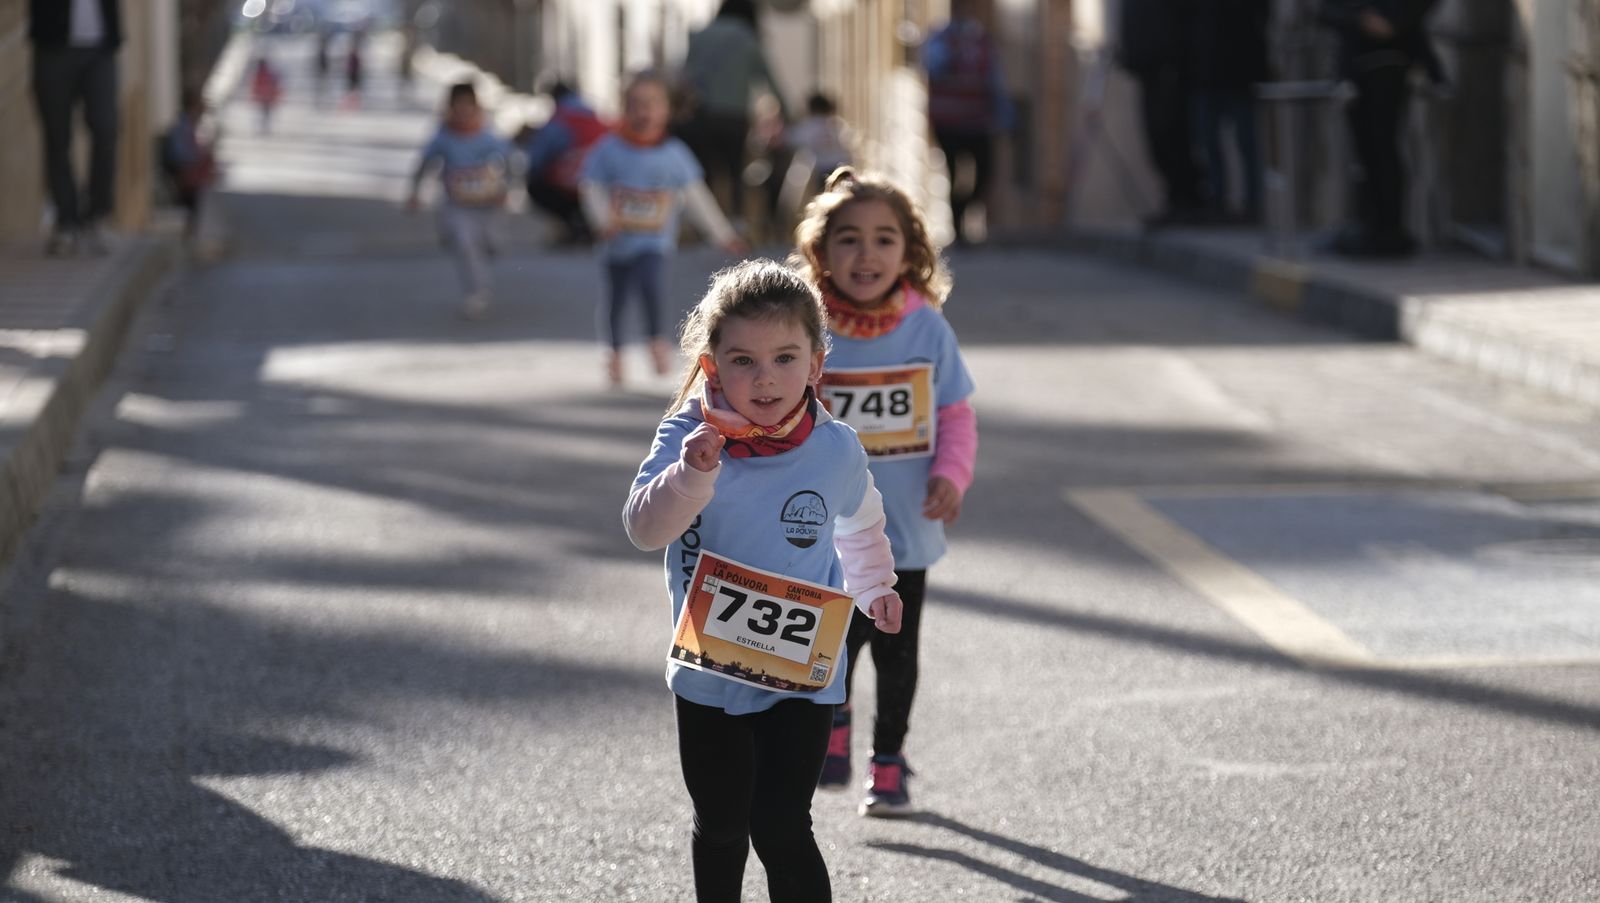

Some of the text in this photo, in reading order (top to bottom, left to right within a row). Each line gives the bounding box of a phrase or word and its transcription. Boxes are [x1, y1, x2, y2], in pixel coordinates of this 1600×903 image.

[833, 389, 909, 418] 748
[713, 567, 724, 579] LA
[787, 584, 822, 600] CANTORIA
[716, 585, 816, 647] 732
[736, 635, 776, 652] ESTRELLA
